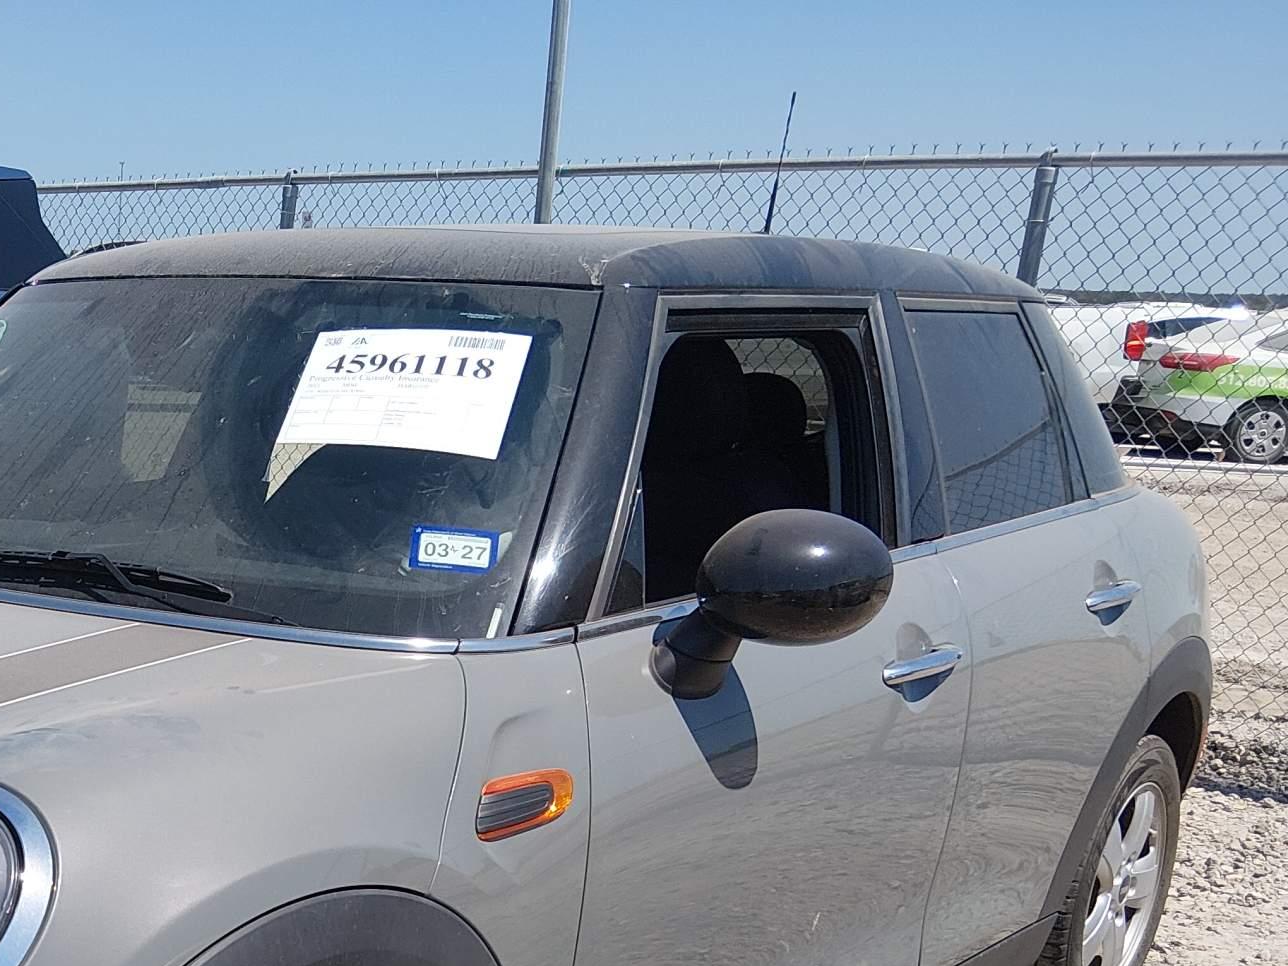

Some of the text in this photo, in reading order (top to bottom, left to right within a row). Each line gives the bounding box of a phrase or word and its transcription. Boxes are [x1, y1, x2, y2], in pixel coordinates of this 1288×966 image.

[325, 353, 496, 379] 45961118
[424, 542, 488, 561] 03 27
